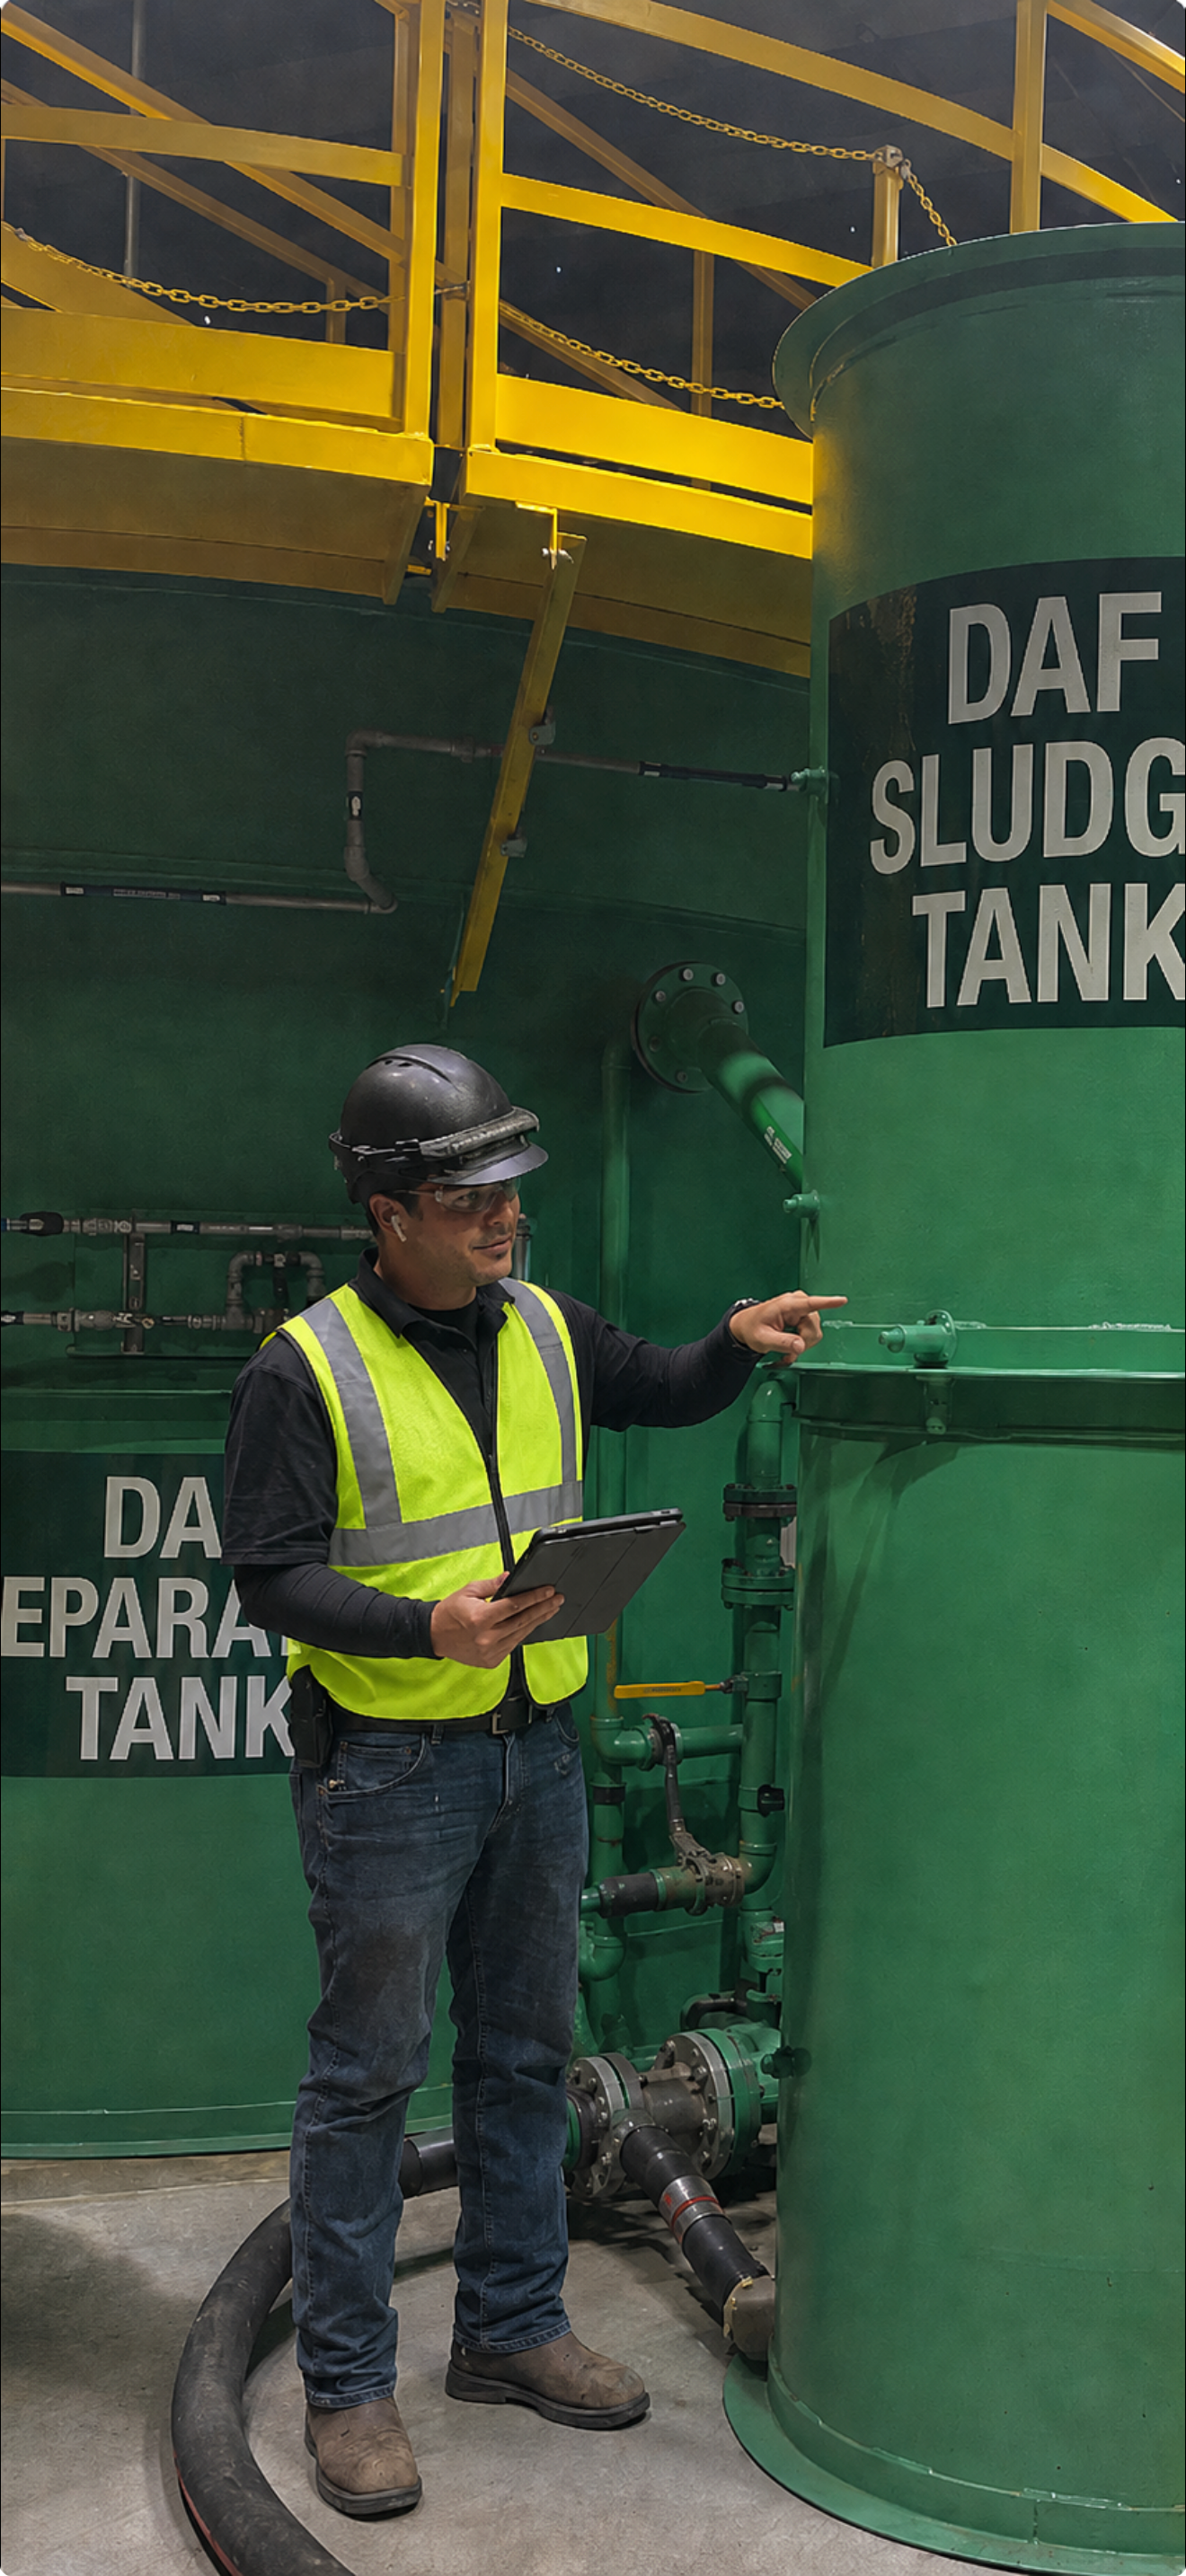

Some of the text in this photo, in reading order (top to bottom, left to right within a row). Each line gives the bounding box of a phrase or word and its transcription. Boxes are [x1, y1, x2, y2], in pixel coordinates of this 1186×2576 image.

[947, 590, 1163, 726] DAF
[869, 736, 1186, 876] SLUDG
[911, 882, 1186, 1009] TANK
[102, 1475, 223, 1559] DA
[0, 1575, 289, 1659] EPARA
[65, 1674, 296, 1761] TANK
